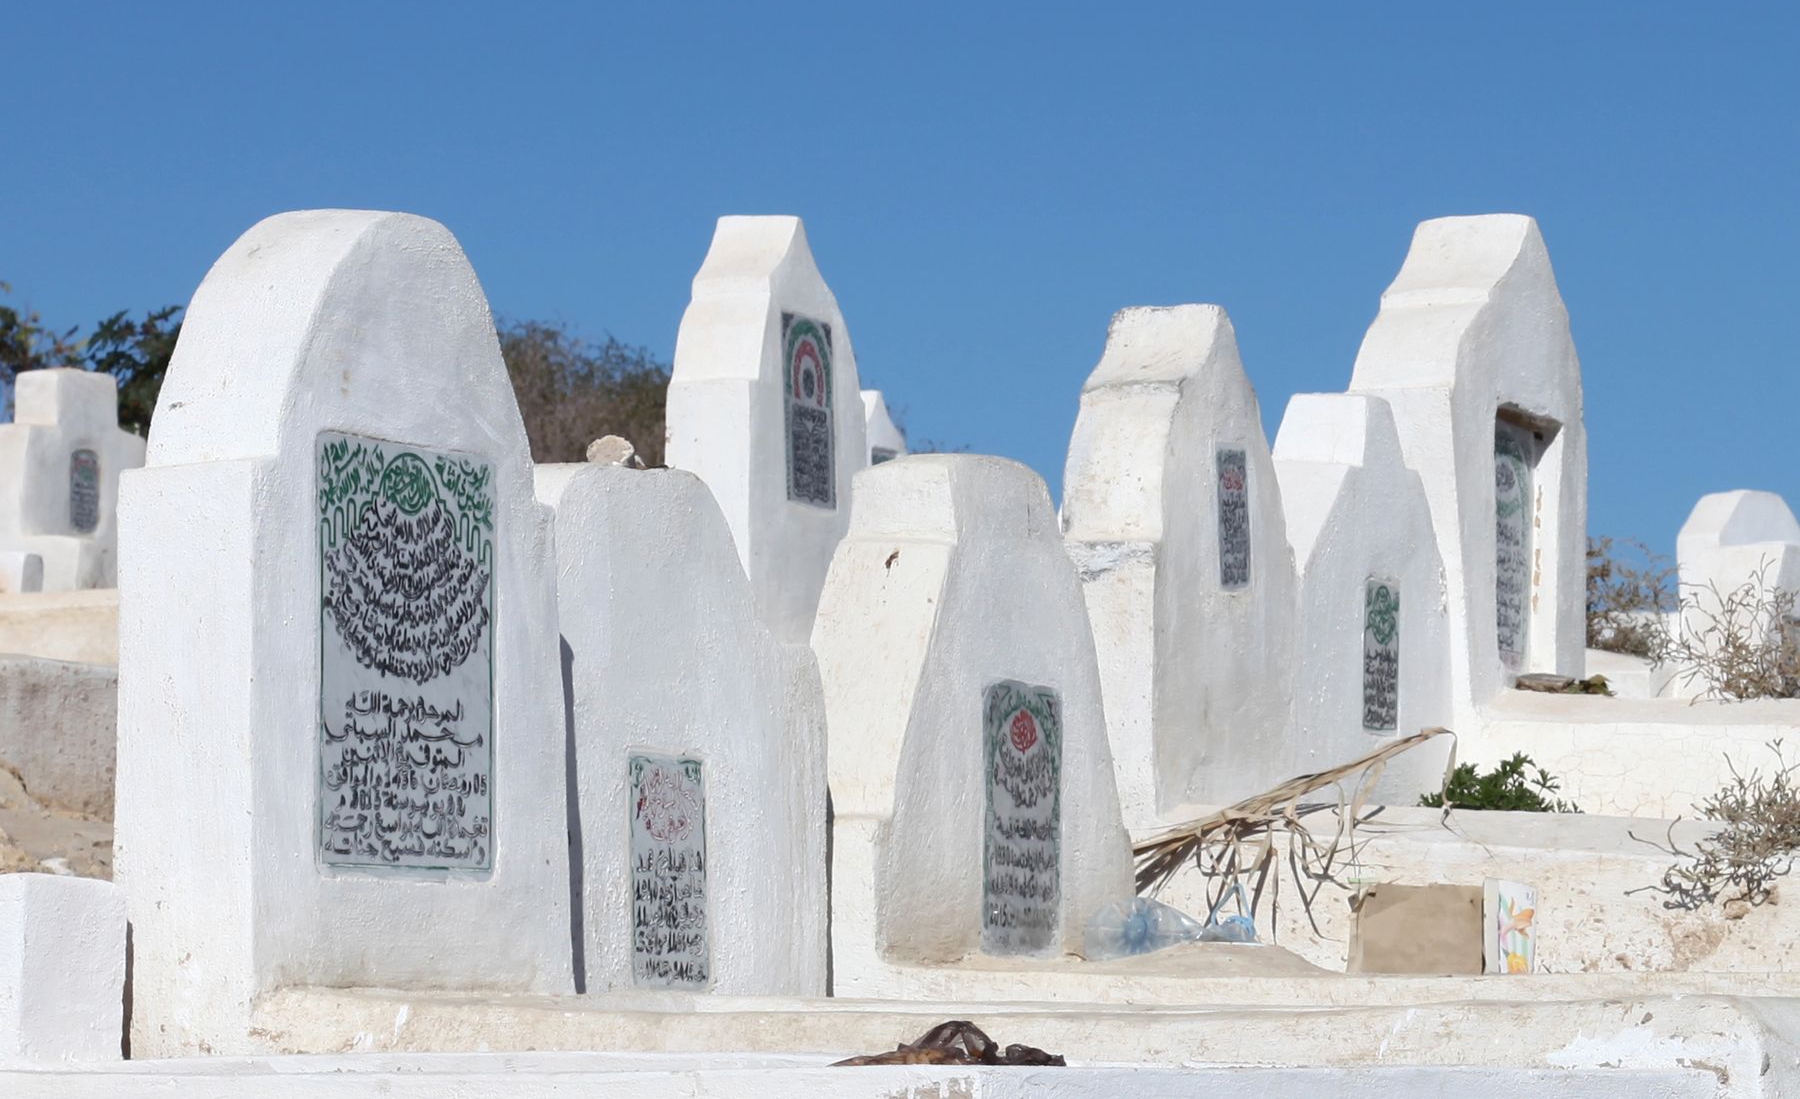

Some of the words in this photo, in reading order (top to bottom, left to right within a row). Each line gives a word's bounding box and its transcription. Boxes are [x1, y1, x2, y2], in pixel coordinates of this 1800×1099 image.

[401, 720, 484, 748] محمد
[384, 768, 418, 790] 1436
[422, 768, 472, 798] رمضان
[472, 773, 488, 796] 05
[350, 788, 382, 811] 2015
[382, 790, 409, 811] سنة
